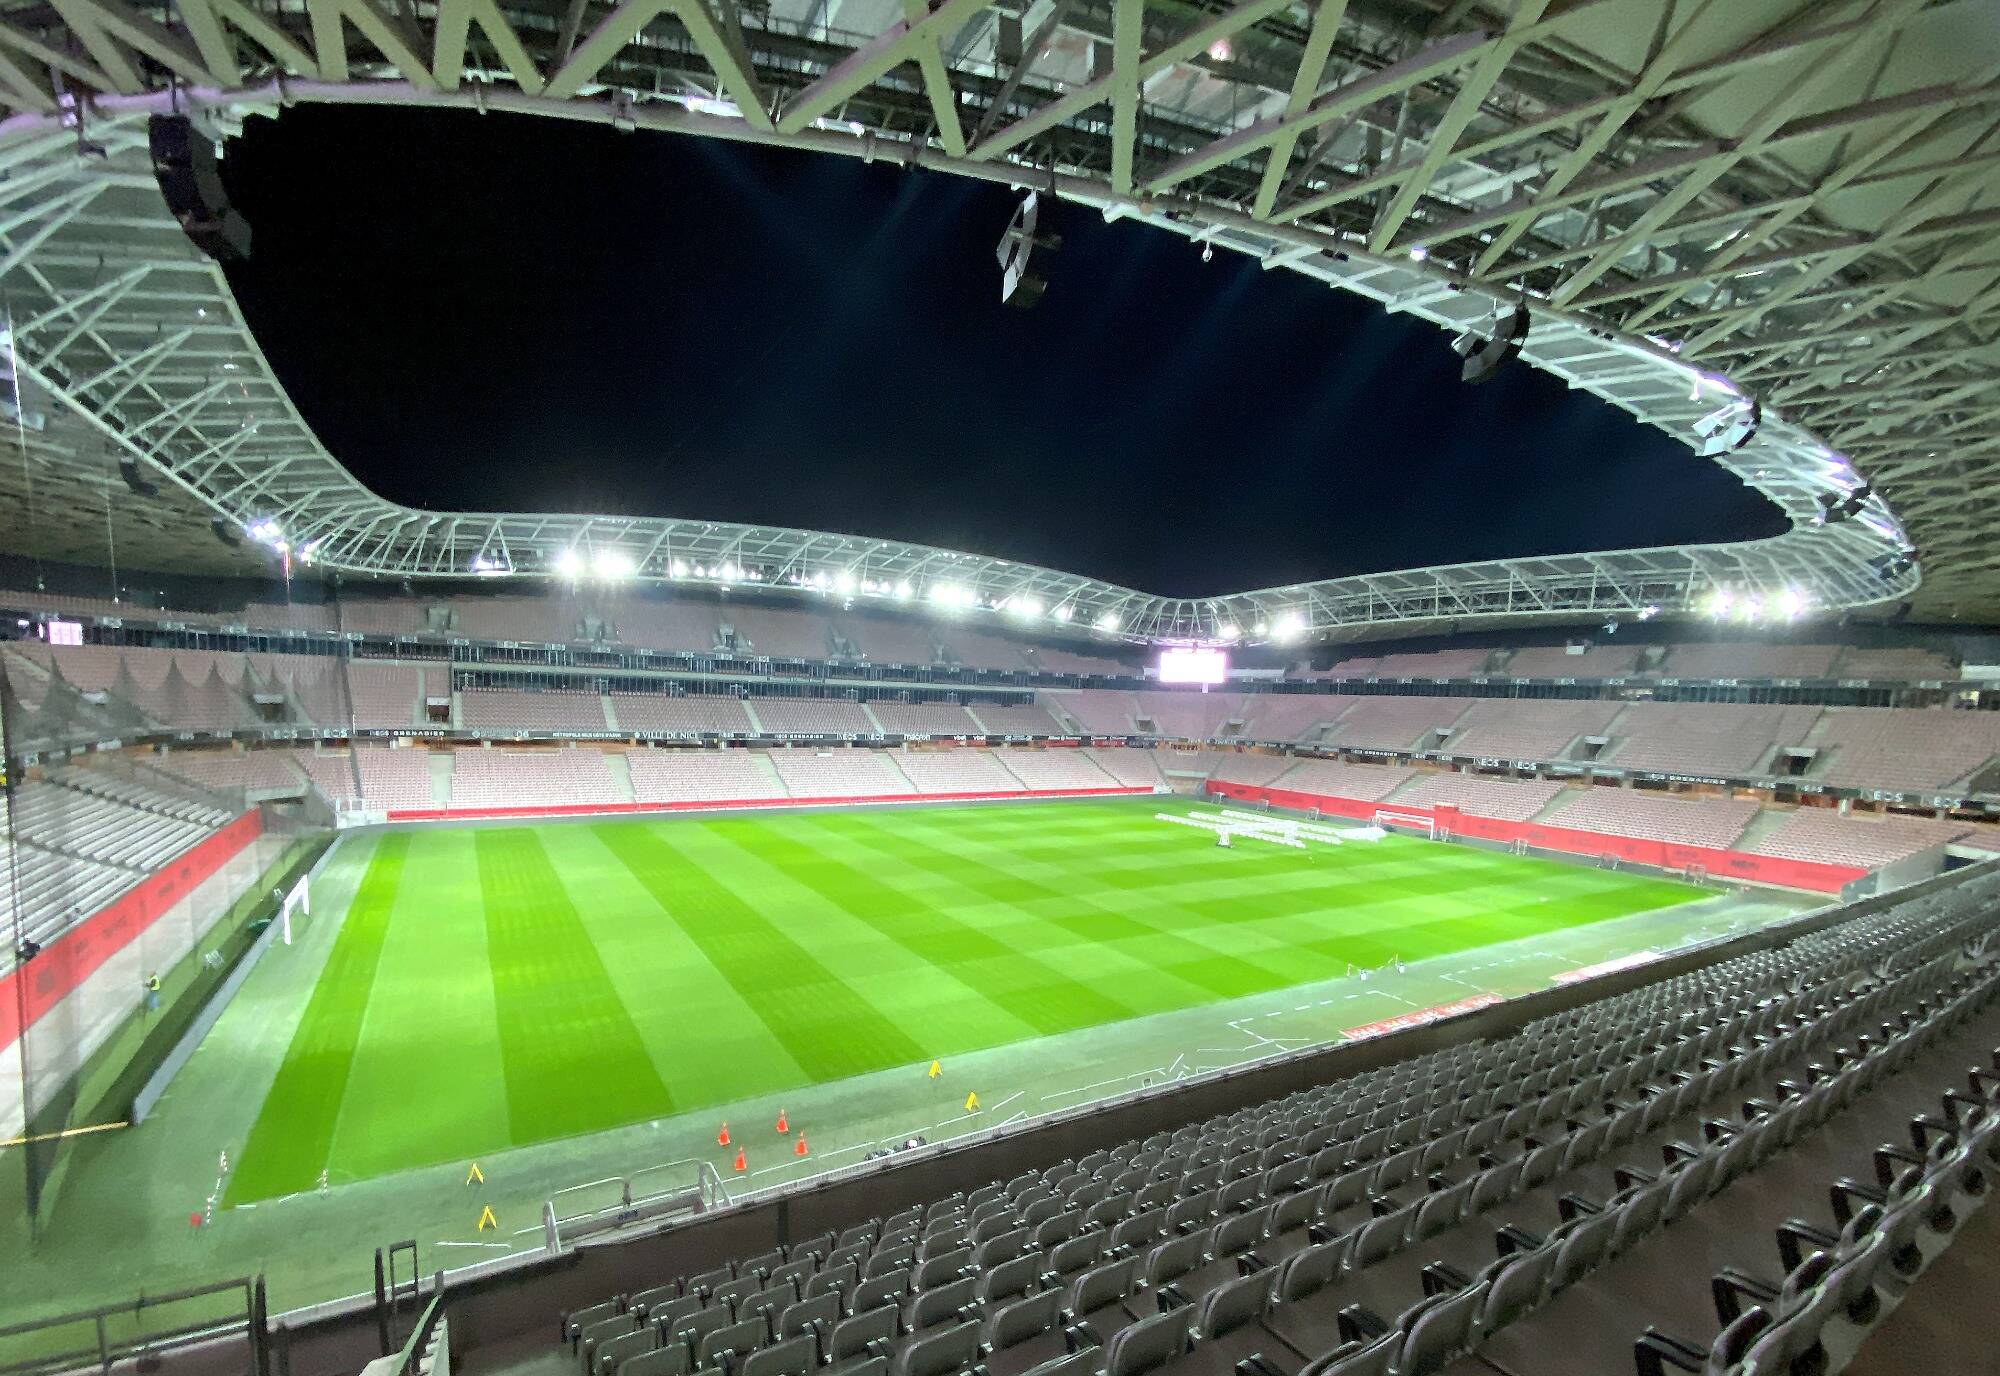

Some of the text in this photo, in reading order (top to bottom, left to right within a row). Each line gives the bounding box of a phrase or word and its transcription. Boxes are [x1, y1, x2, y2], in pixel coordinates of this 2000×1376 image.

[836, 733, 858, 741] INEOS
[864, 733, 885, 741] INEOS
[1474, 757, 1499, 768] INEOS
[1509, 760, 1537, 771] INEOS
